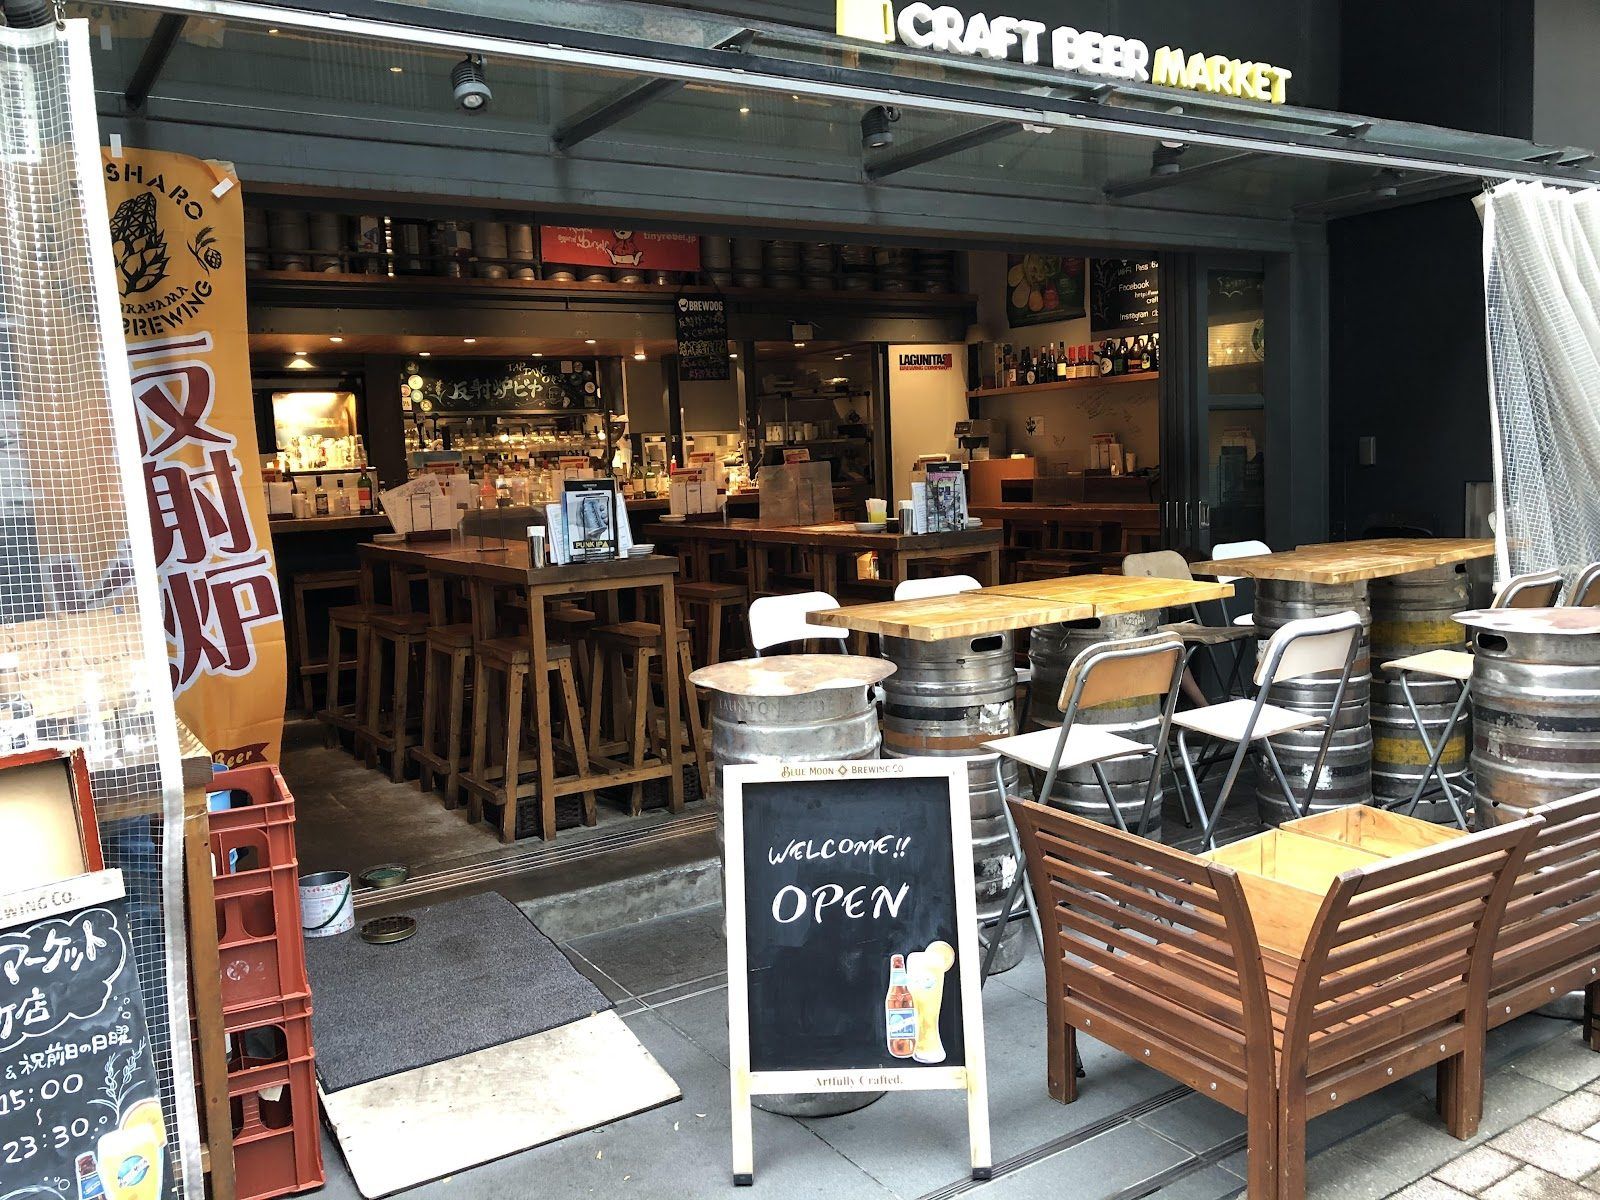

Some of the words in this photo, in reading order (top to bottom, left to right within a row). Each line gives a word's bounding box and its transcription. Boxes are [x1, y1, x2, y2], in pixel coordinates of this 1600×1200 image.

[898, 1, 1046, 65] CRAFT
[1052, 26, 1150, 82] BEER
[1151, 45, 1293, 104] MARKET
[1118, 279, 1150, 292] Facebook
[689, 301, 723, 312] BREWDOG
[575, 541, 595, 549] PUNK
[596, 540, 609, 548] IPA
[781, 765, 806, 778] BLUE
[809, 766, 834, 775] MOON
[851, 764, 891, 774] BREWING
[768, 835, 911, 866] WELCOME!!
[772, 882, 910, 924] OPEN
[814, 1076, 856, 1089] Artfully
[0, 1073, 83, 1115] 15:00
[3, 1117, 89, 1164] 23:30
